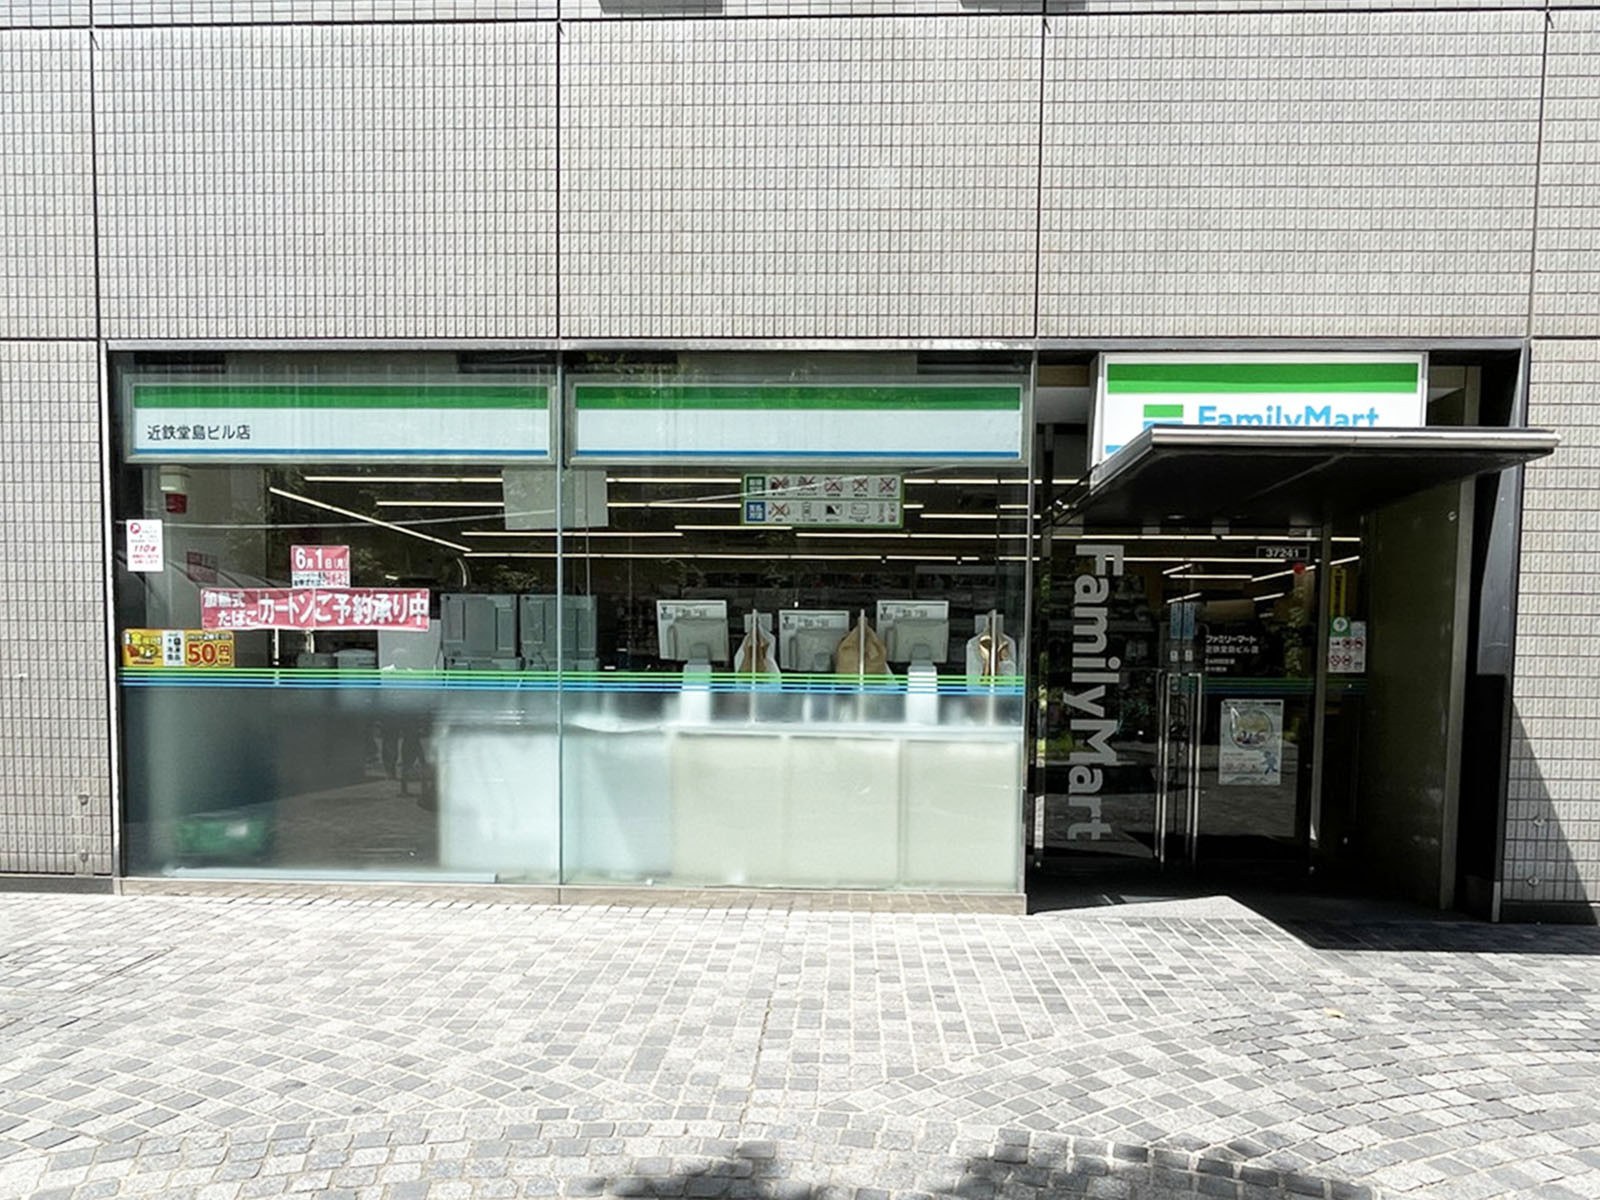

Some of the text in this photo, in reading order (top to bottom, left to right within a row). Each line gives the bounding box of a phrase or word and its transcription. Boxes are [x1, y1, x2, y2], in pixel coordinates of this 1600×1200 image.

[147, 424, 251, 441] 近鉄堂島ビル店
[1265, 548, 1300, 558] 37241
[218, 609, 258, 627] たばこ
[1205, 634, 1257, 644] ファミリーマート
[1062, 544, 1125, 841] FamilyMart
